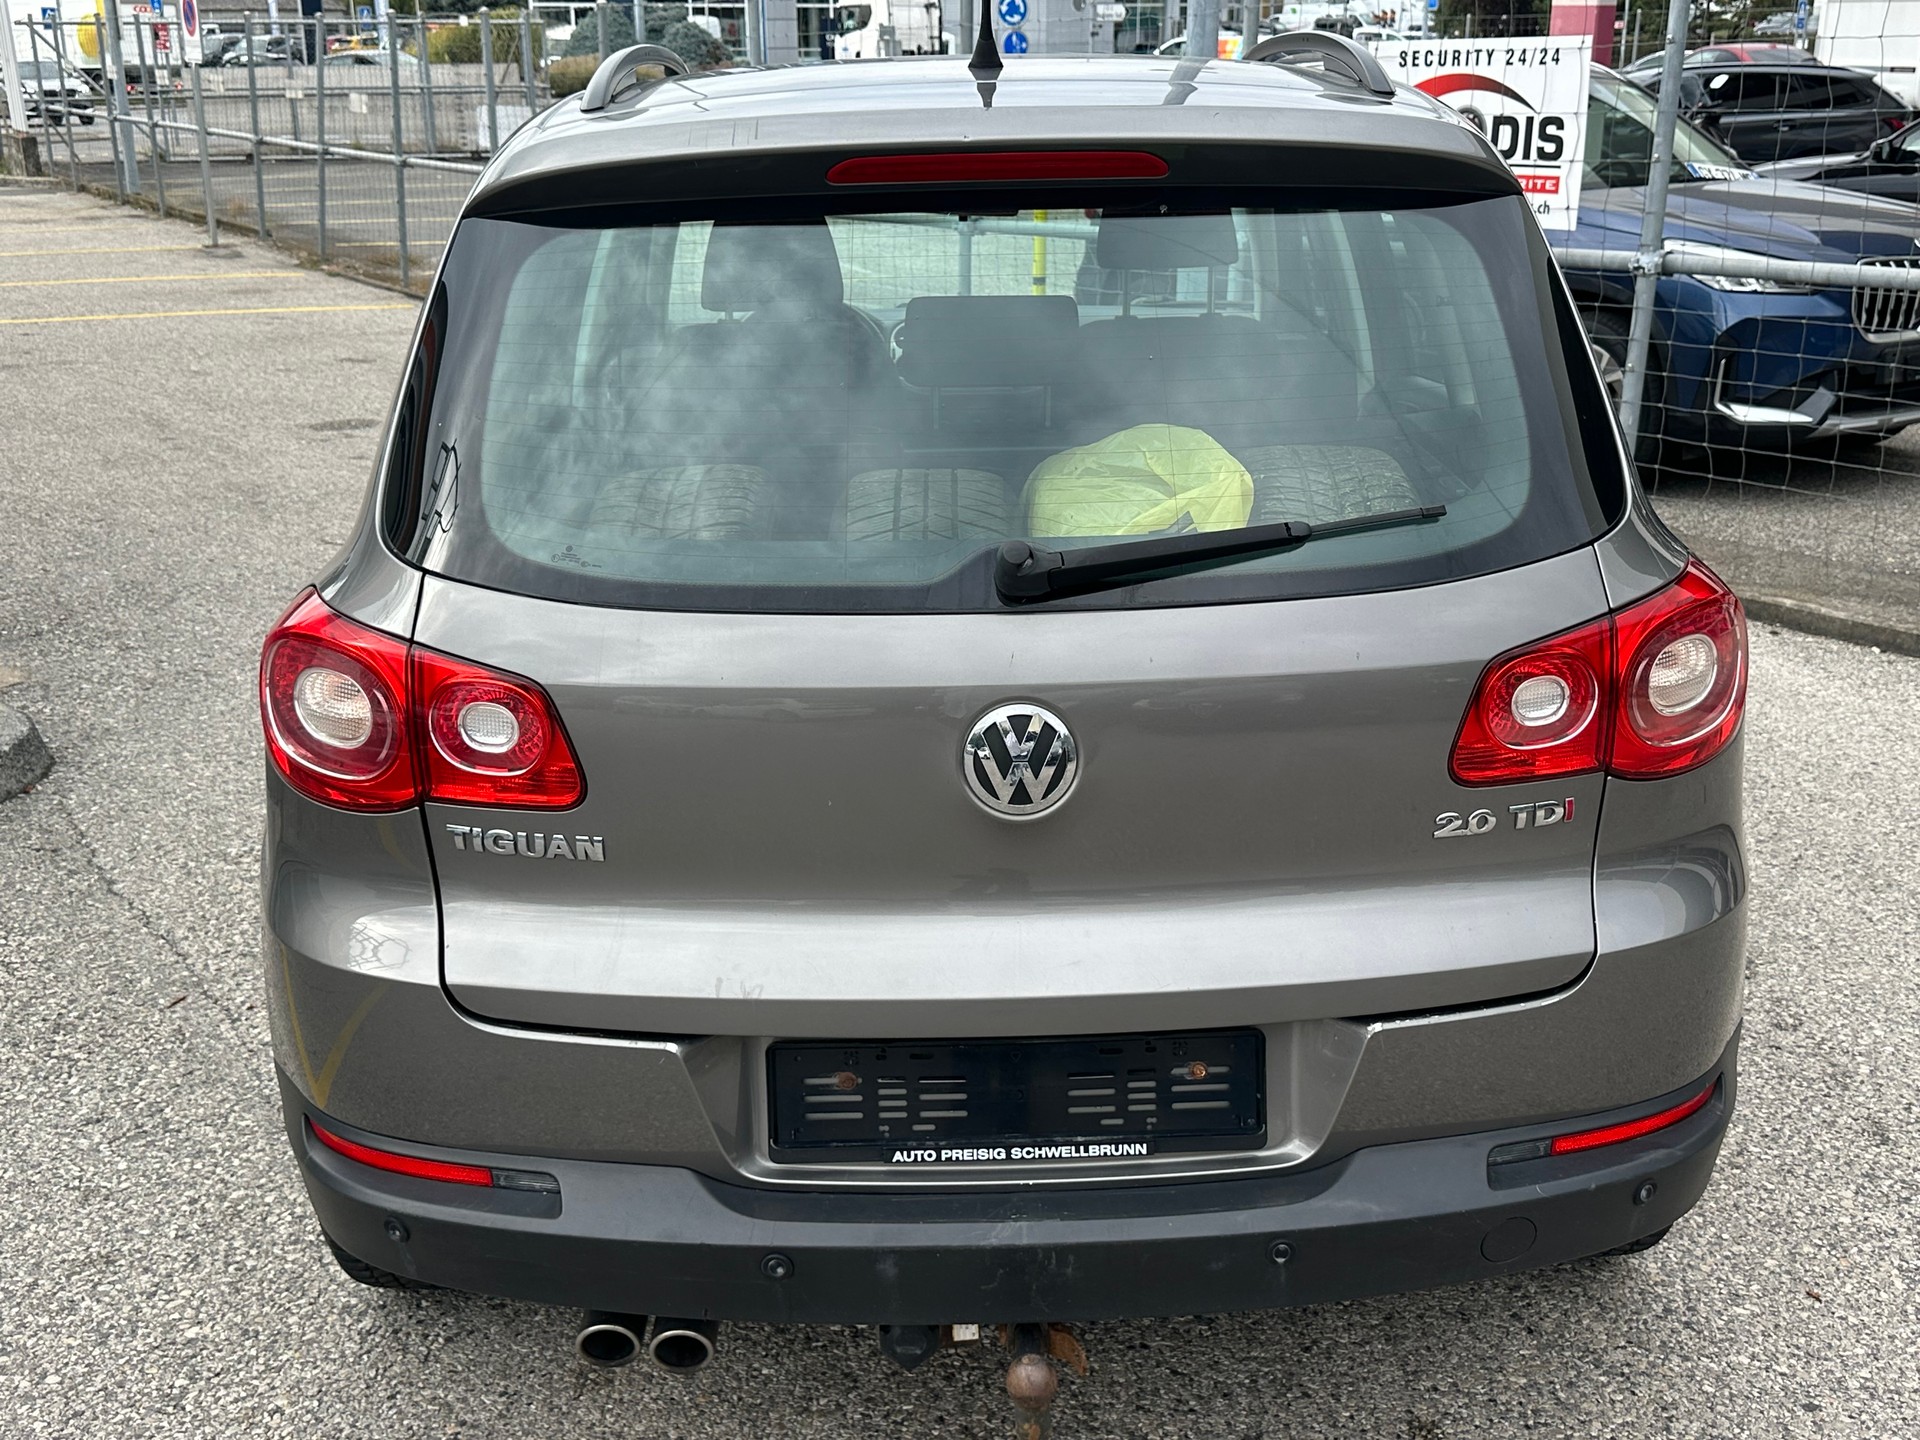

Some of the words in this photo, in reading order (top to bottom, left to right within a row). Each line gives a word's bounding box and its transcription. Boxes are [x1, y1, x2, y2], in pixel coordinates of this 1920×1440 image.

[1399, 48, 1496, 68] SECURITY
[1505, 47, 1561, 68] 24/24
[1508, 796, 1576, 830] TDI
[446, 823, 606, 862] TIGUAN
[891, 1149, 937, 1163] AUTO
[941, 1146, 1007, 1161] PREISIG
[1010, 1142, 1148, 1160] SCHWELLBRUNN
